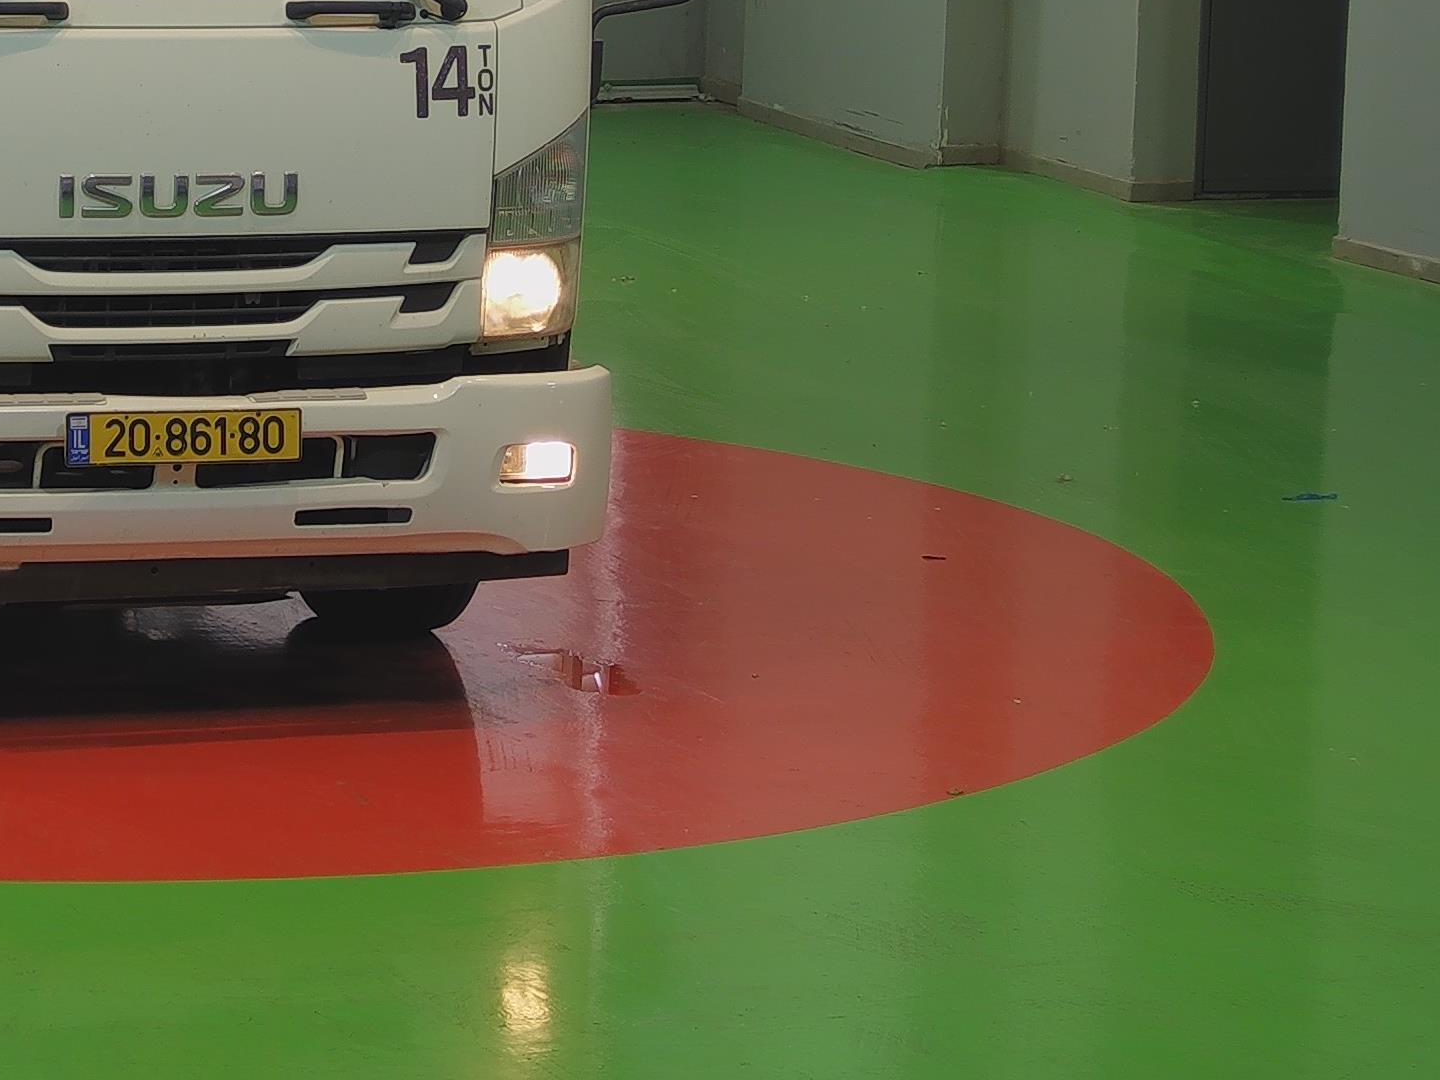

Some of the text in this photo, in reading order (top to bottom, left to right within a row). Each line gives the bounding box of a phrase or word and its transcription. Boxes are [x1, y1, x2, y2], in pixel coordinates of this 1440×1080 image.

[399, 44, 494, 119] 14 TON
[58, 170, 299, 219] ISUZU
[73, 429, 86, 449] IL
